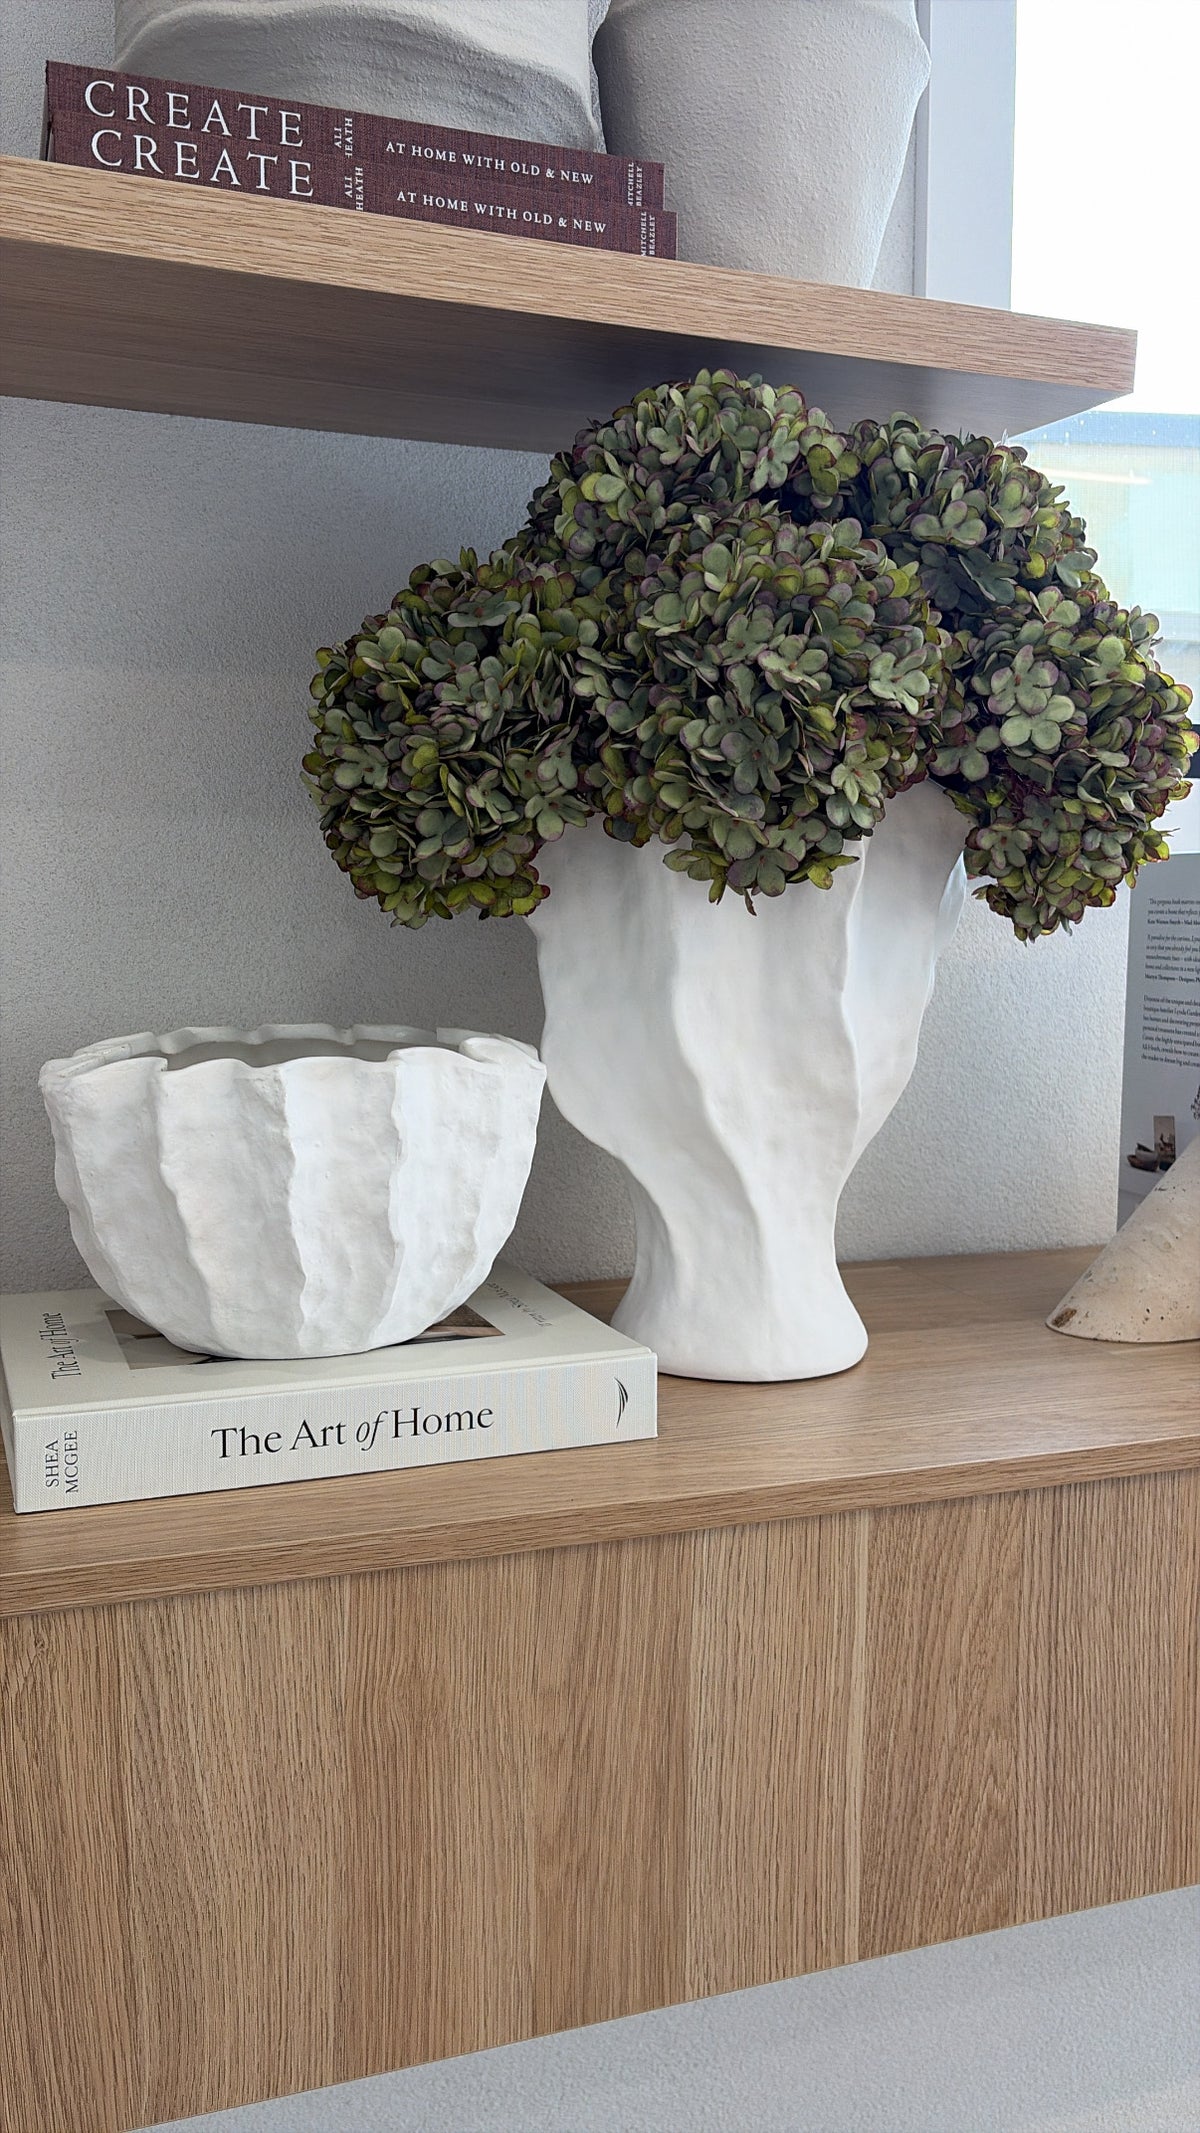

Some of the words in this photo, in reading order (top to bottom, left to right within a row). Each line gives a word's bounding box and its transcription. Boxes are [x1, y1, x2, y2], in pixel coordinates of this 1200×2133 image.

[84, 80, 303, 148] CREATE
[334, 126, 342, 149] ALI
[91, 129, 314, 197] CREATE
[386, 141, 406, 154] AT
[411, 145, 457, 163] HOME
[462, 153, 505, 171] WITH
[510, 161, 540, 176] OLD
[545, 168, 555, 179] &
[560, 169, 593, 184] NEW
[345, 175, 353, 198] ALI
[355, 166, 364, 211] HEATH
[396, 190, 417, 203] AT
[422, 194, 468, 212] HOME
[474, 202, 517, 220] WITH
[522, 211, 553, 225] OLD
[558, 217, 567, 228] &
[573, 218, 606, 233] NEW
[39, 1312, 68, 1337] Home
[46, 1345, 75, 1359] Art
[51, 1361, 82, 1379] The
[210, 1426, 282, 1459] The
[289, 1419, 347, 1451] Art
[355, 1410, 389, 1452] of
[391, 1407, 493, 1439] Home
[45, 1440, 60, 1488] SHEA
[64, 1430, 79, 1494] MCGEE
